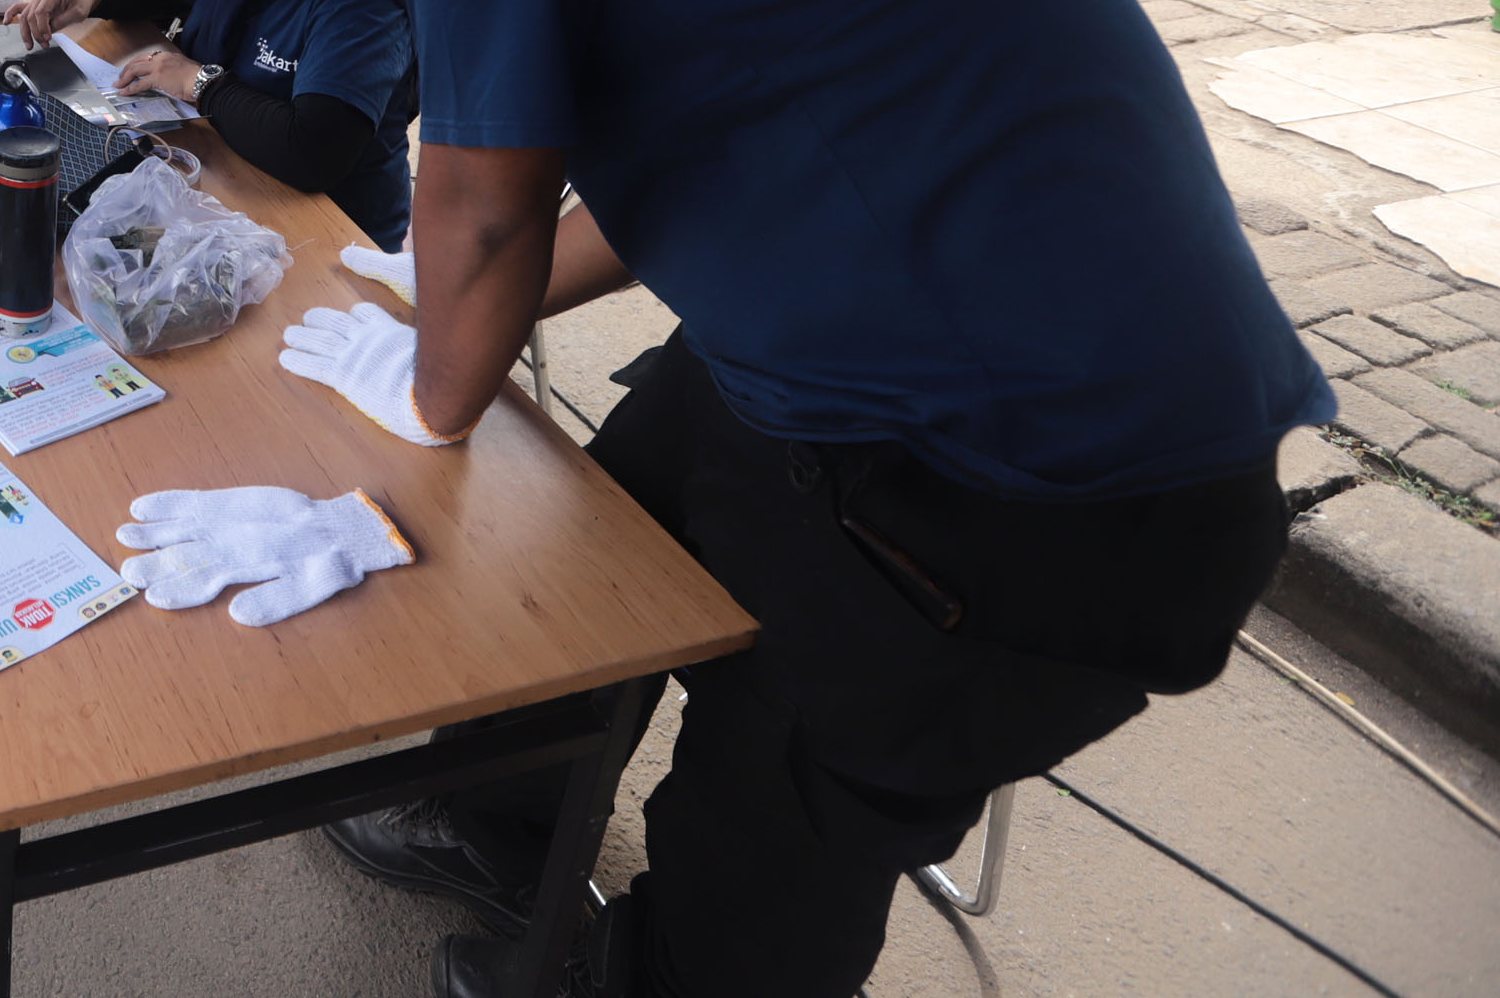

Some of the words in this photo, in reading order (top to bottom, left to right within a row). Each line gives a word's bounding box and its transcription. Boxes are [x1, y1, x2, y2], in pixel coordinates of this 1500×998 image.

[256, 49, 299, 72] Jakart
[47, 574, 102, 608] SANKSI
[20, 606, 53, 628] TIDAK
